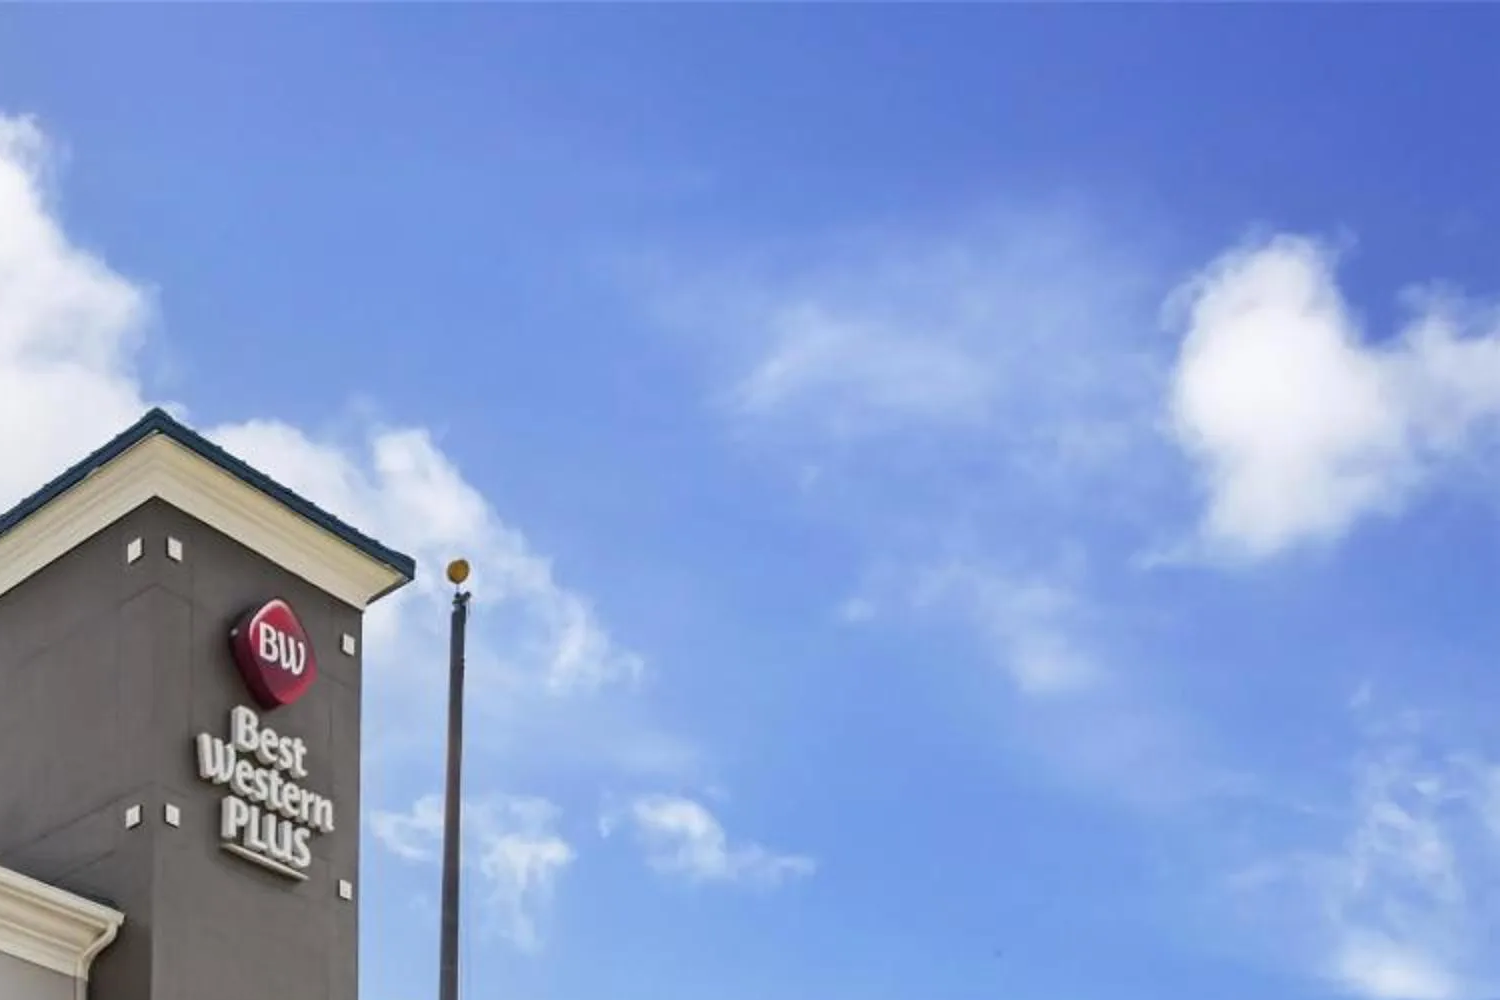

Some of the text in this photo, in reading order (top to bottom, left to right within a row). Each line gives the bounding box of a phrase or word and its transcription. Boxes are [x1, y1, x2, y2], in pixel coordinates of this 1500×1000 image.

[258, 621, 305, 676] BW
[230, 704, 308, 778] Best
[197, 732, 335, 833] Western
[220, 795, 312, 869] PLUS
